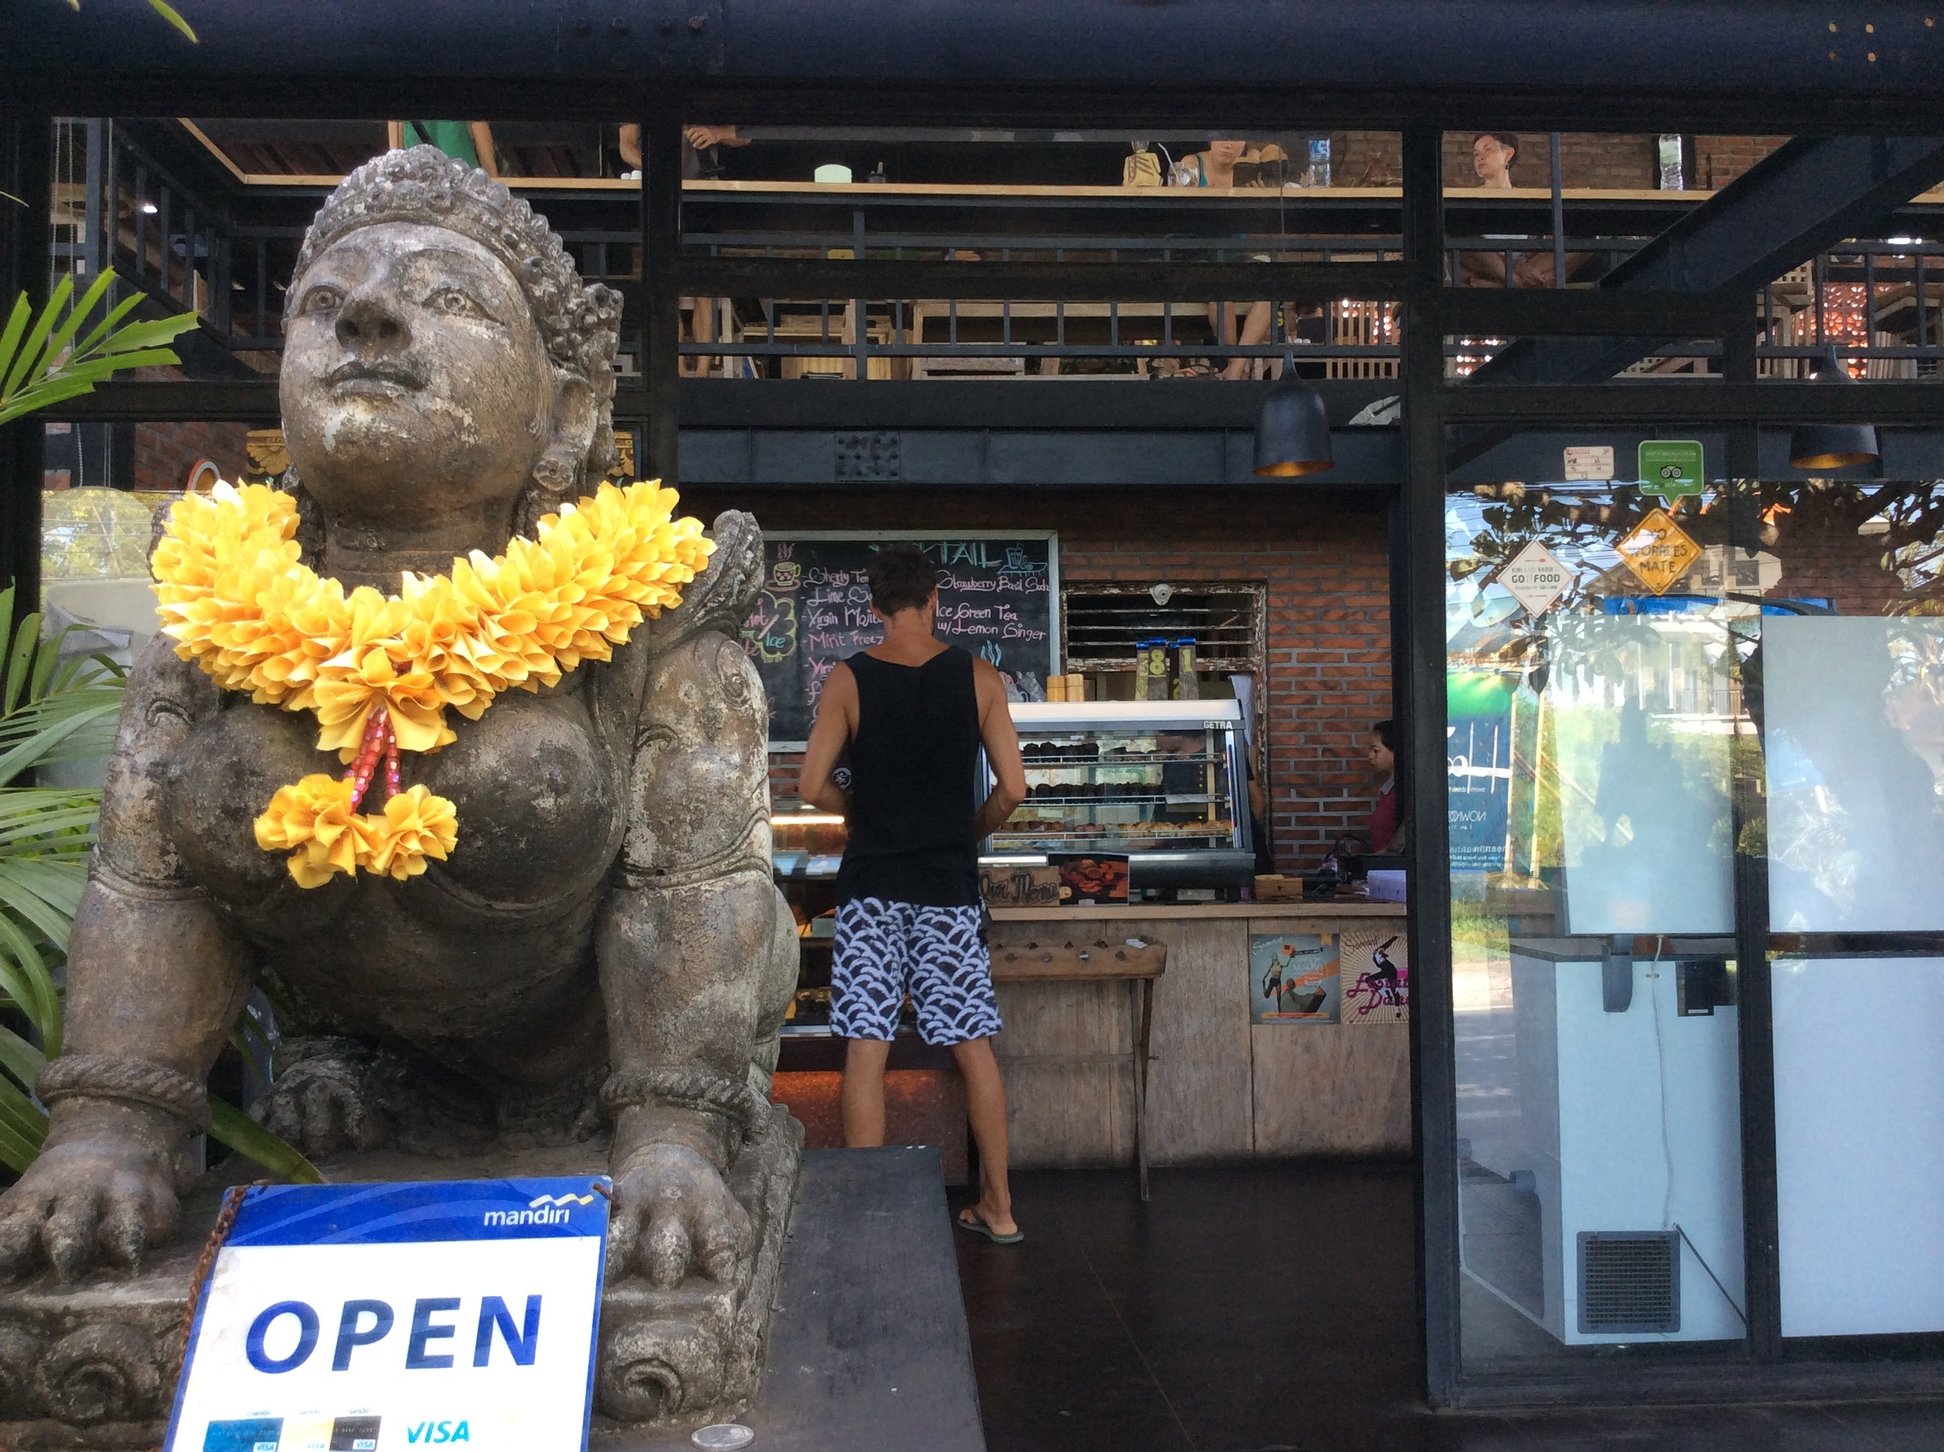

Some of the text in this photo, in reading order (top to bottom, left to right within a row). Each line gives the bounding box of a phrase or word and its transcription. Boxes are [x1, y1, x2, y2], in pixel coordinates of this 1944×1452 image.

[1639, 560, 1676, 574] MATE
[936, 569, 1050, 595] Strawberry Basil Soda
[1511, 574, 1561, 584] GO FOOD
[806, 587, 846, 606] Lime
[806, 606, 883, 630] Virgin Mojit
[936, 599, 1018, 620] Ice Green Tea
[766, 631, 786, 648] Ice
[808, 631, 846, 651] Mint
[1001, 622, 1047, 641] Ginger
[1203, 720, 1233, 730] GETRA
[483, 1205, 570, 1227] mandiri
[245, 1294, 543, 1374] OPEN
[407, 1420, 471, 1444] VISA
[256, 1443, 275, 1452] VISA
